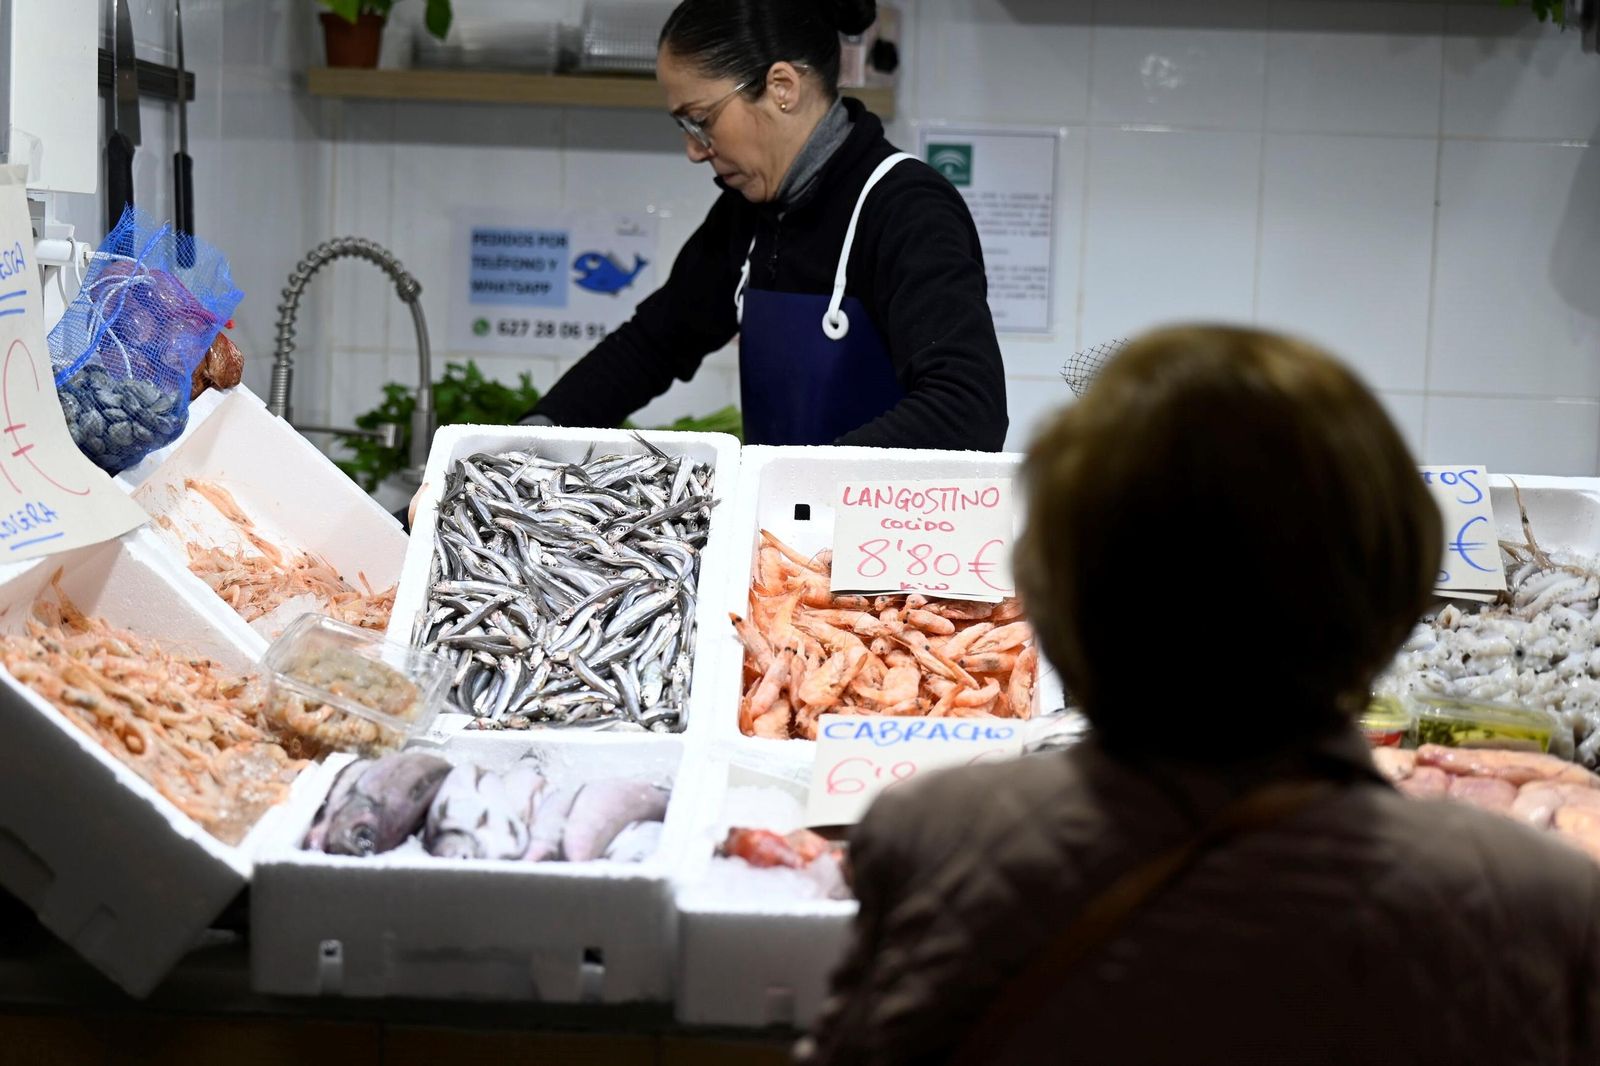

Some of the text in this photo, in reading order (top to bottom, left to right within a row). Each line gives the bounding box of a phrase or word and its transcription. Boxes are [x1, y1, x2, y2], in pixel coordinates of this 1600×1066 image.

[538, 233, 569, 249] POR
[497, 319, 530, 337] 627
[534, 320, 556, 338] 28
[1418, 470, 1483, 504] TOS
[842, 486, 1000, 514] LANGOSTINO
[824, 721, 1014, 746] CABRACHO
